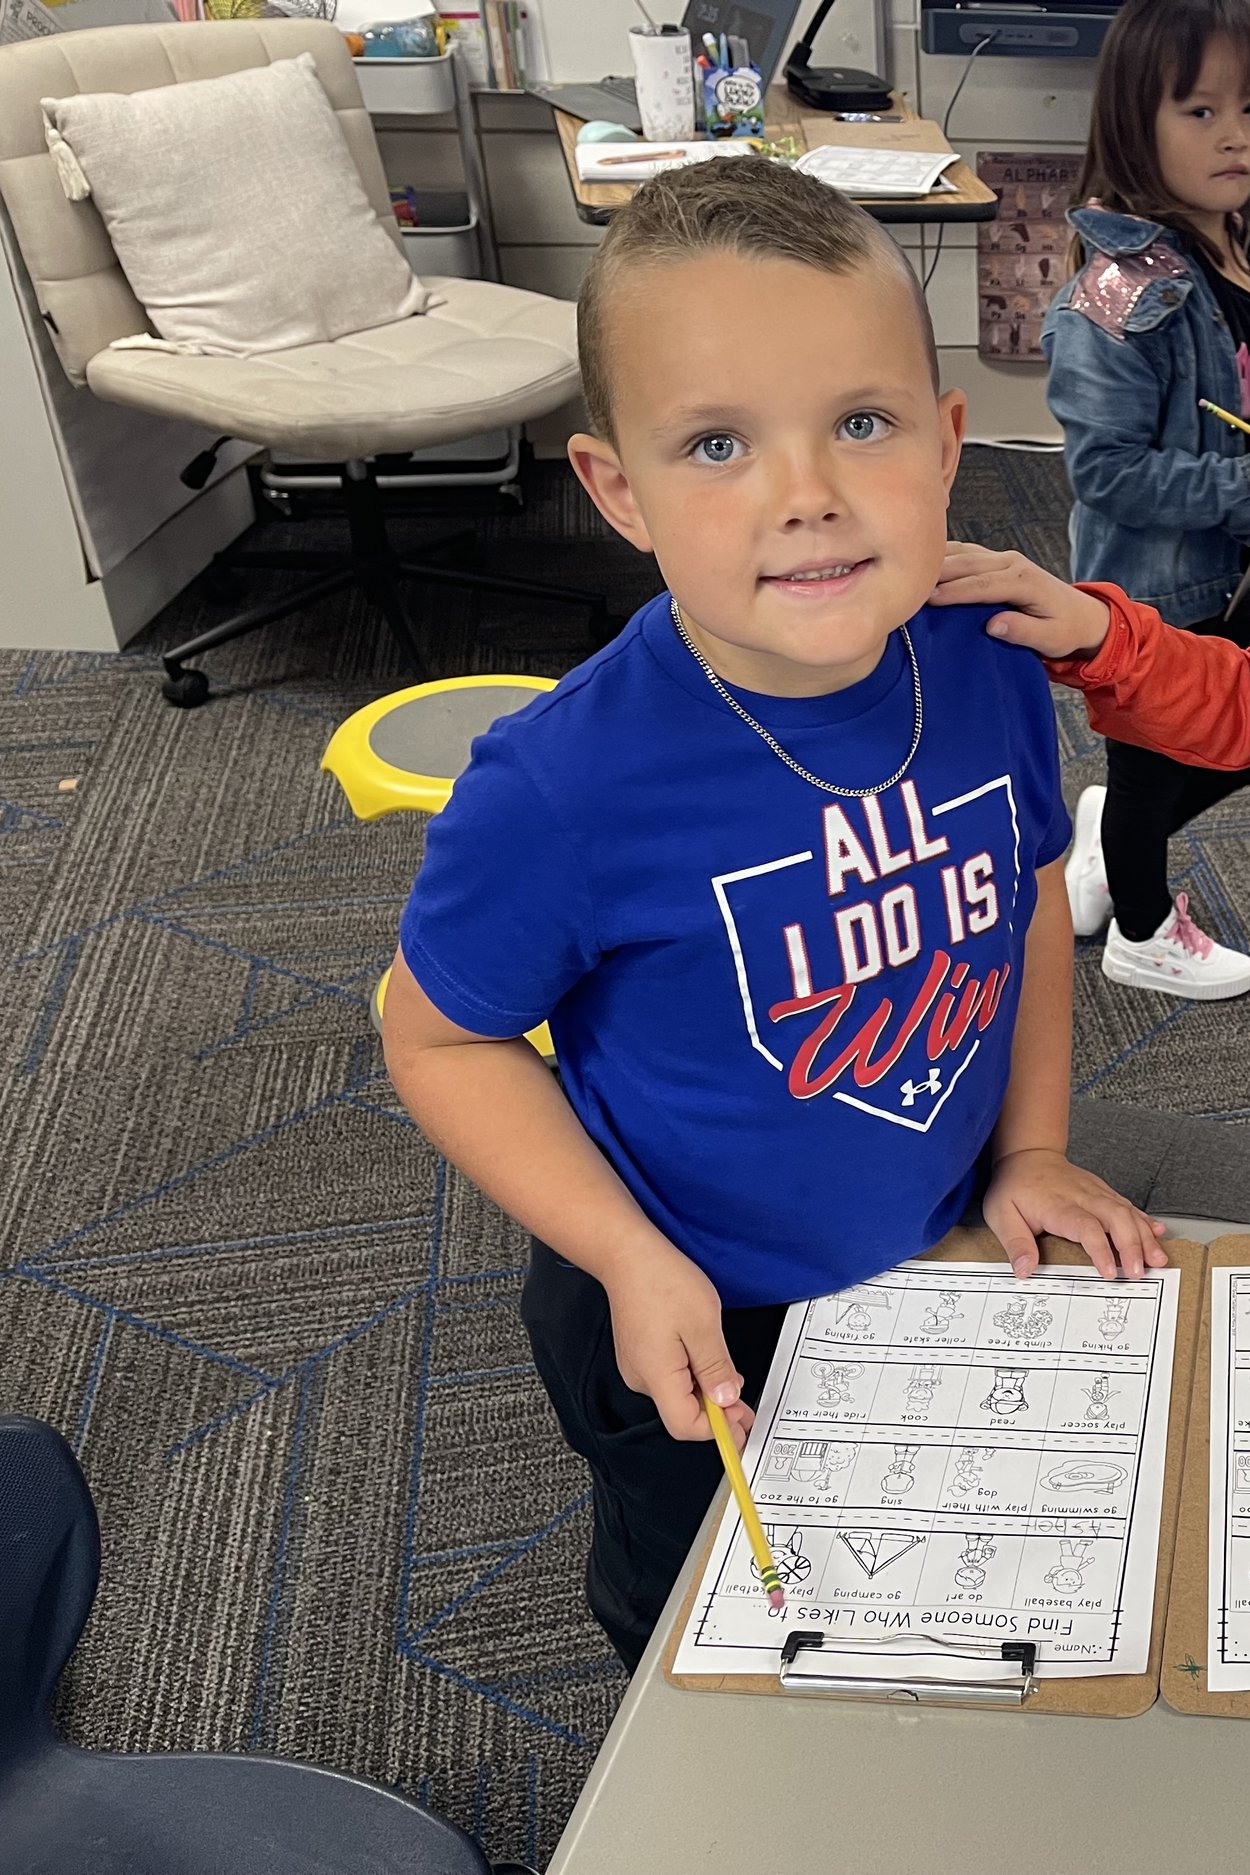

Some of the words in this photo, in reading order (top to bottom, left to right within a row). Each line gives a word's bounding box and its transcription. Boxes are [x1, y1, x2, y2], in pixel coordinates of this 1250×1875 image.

[822, 779, 950, 896] ALL
[783, 922, 815, 1000] I
[834, 882, 921, 985] DO
[940, 851, 999, 944] IS
[768, 950, 1011, 1099] Win
[825, 1328, 859, 1341] fishing
[863, 1331, 876, 1340] go
[903, 1335, 930, 1343] skate
[934, 1336, 966, 1344] roller
[988, 1339, 1011, 1347] tree
[1082, 1341, 1113, 1350] hiking
[785, 1409, 808, 1418] bike
[813, 1410, 839, 1418] their
[844, 1411, 866, 1419] ride
[900, 1414, 929, 1422] cook
[990, 1418, 1016, 1426] read
[1104, 1422, 1126, 1430] play
[774, 1444, 797, 1456] ZOO
[760, 1493, 781, 1501] zoo
[977, 1488, 998, 1498] dog
[787, 1495, 804, 1503] the
[809, 1495, 819, 1503] to
[825, 1495, 839, 1503] go
[881, 1496, 902, 1505] sing
[942, 1502, 971, 1511] their
[976, 1503, 1001, 1511] with
[1005, 1503, 1028, 1513] play
[1041, 1504, 1099, 1514] swimming
[1103, 1506, 1117, 1514] go
[725, 1584, 784, 1595] ketball
[789, 1586, 814, 1596] play
[834, 1588, 882, 1599] camping
[887, 1590, 901, 1600] go
[946, 1593, 965, 1602] art
[968, 1593, 983, 1601] do
[1024, 1598, 1073, 1607] baseball
[1077, 1599, 1102, 1608] play
[797, 1606, 856, 1626] Likes
[864, 1610, 911, 1628] Who
[920, 1611, 1018, 1633] Someone
[1027, 1619, 1073, 1636] Find
[1054, 1644, 1092, 1654] Name
